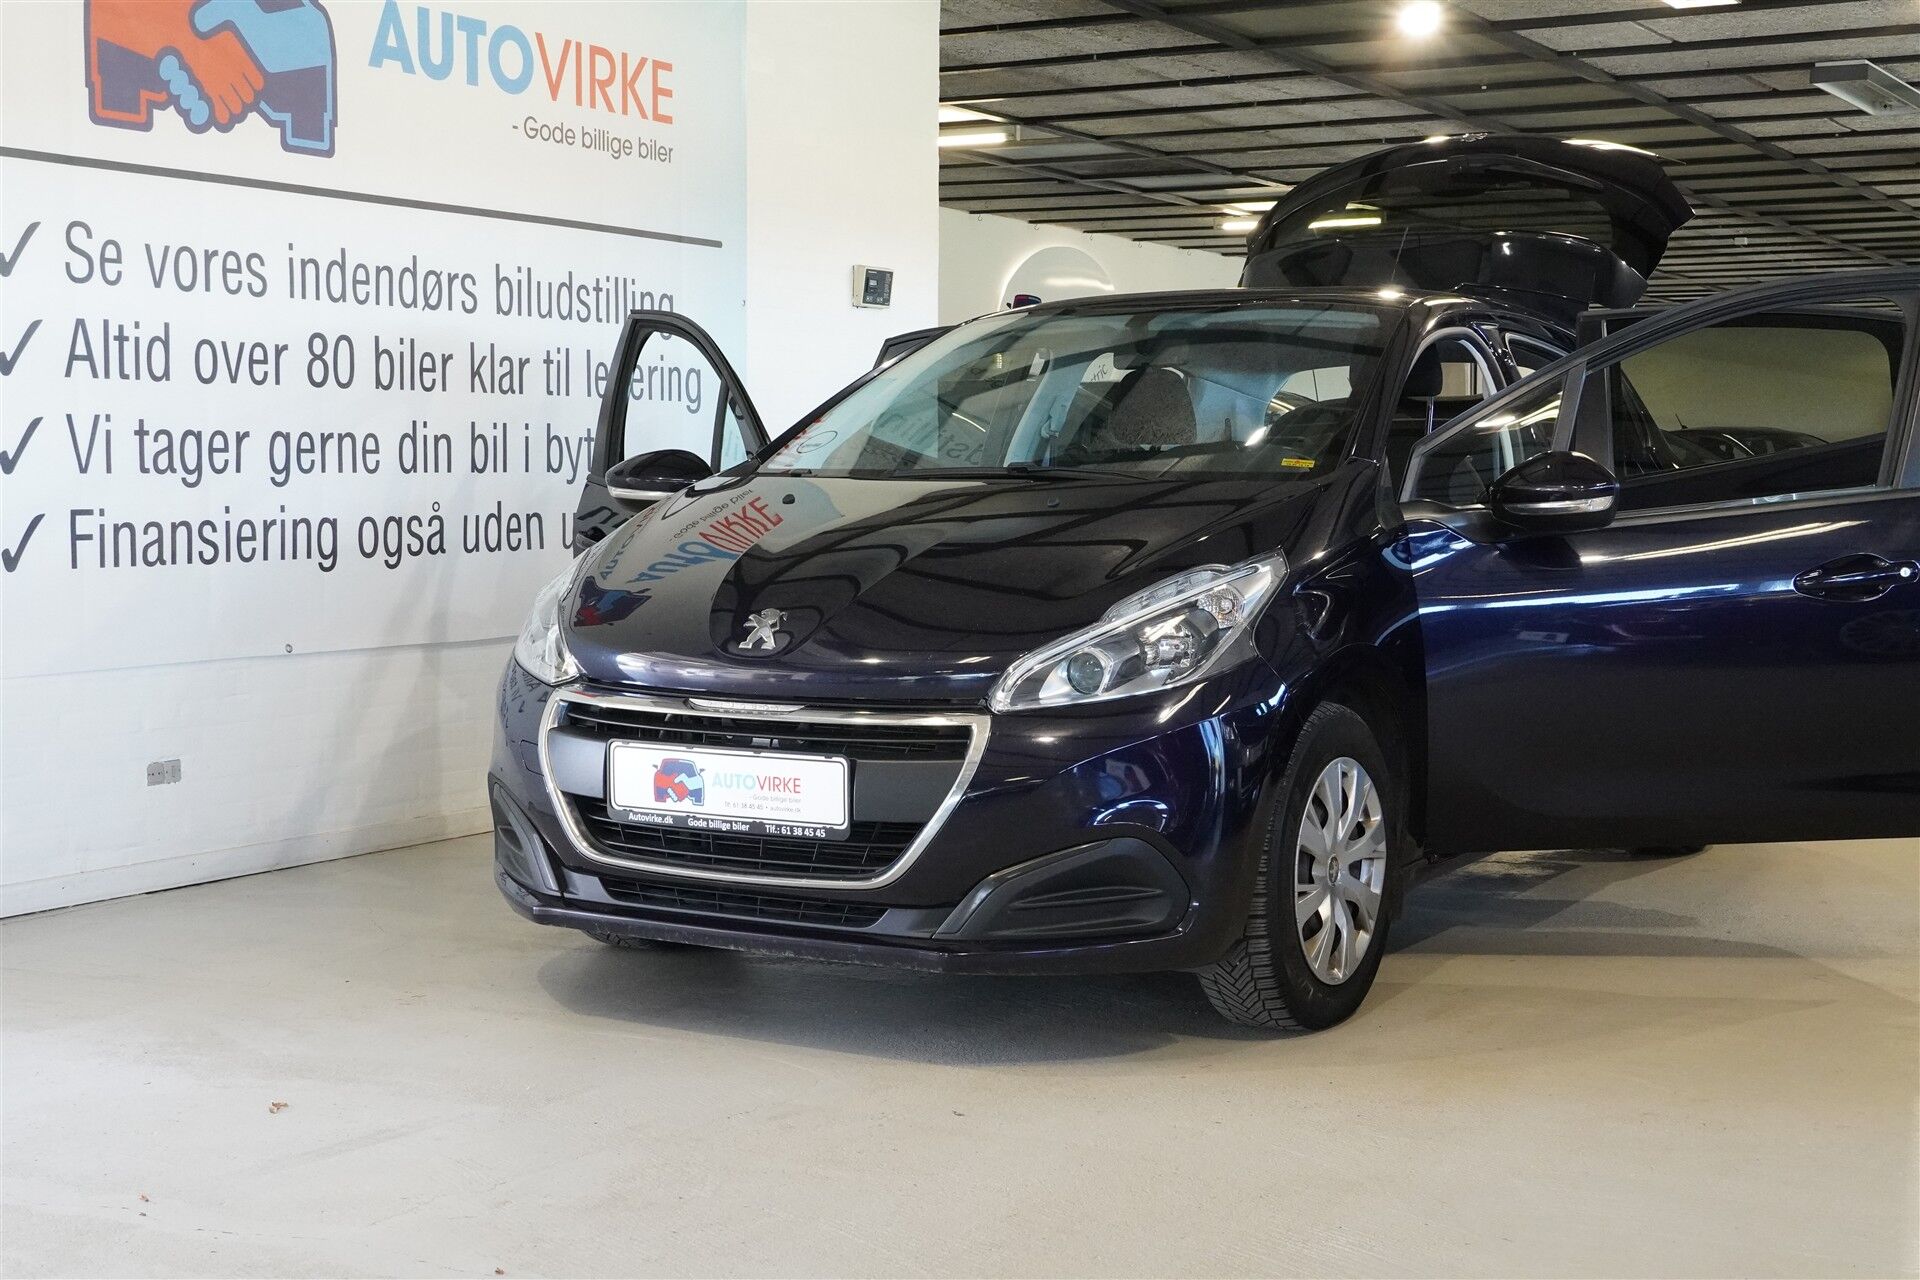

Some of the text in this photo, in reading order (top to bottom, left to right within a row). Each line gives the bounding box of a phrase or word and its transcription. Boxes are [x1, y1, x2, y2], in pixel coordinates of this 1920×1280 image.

[367, 0, 673, 125] AUTOVIRKE
[523, 115, 576, 146] Gode
[581, 126, 633, 160] billige
[638, 136, 673, 163] biler
[65, 220, 123, 286] Se
[145, 243, 268, 298] vores
[288, 243, 478, 315] indendørs
[64, 318, 702, 414] Altid over 80 biler klar til leering
[65, 413, 594, 489] Vi tager gerne din bil i byt
[69, 507, 339, 573] Finansiering
[357, 500, 447, 572] også
[462, 500, 545, 556] uden
[711, 771, 801, 794] AUTOVIRKE
[628, 812, 674, 825] Autovirke.dk
[687, 817, 750, 832] Gode billige biler
[781, 825, 791, 836] 61
[792, 826, 803, 837] 38
[804, 827, 814, 838] 45
[815, 828, 826, 838] 45
